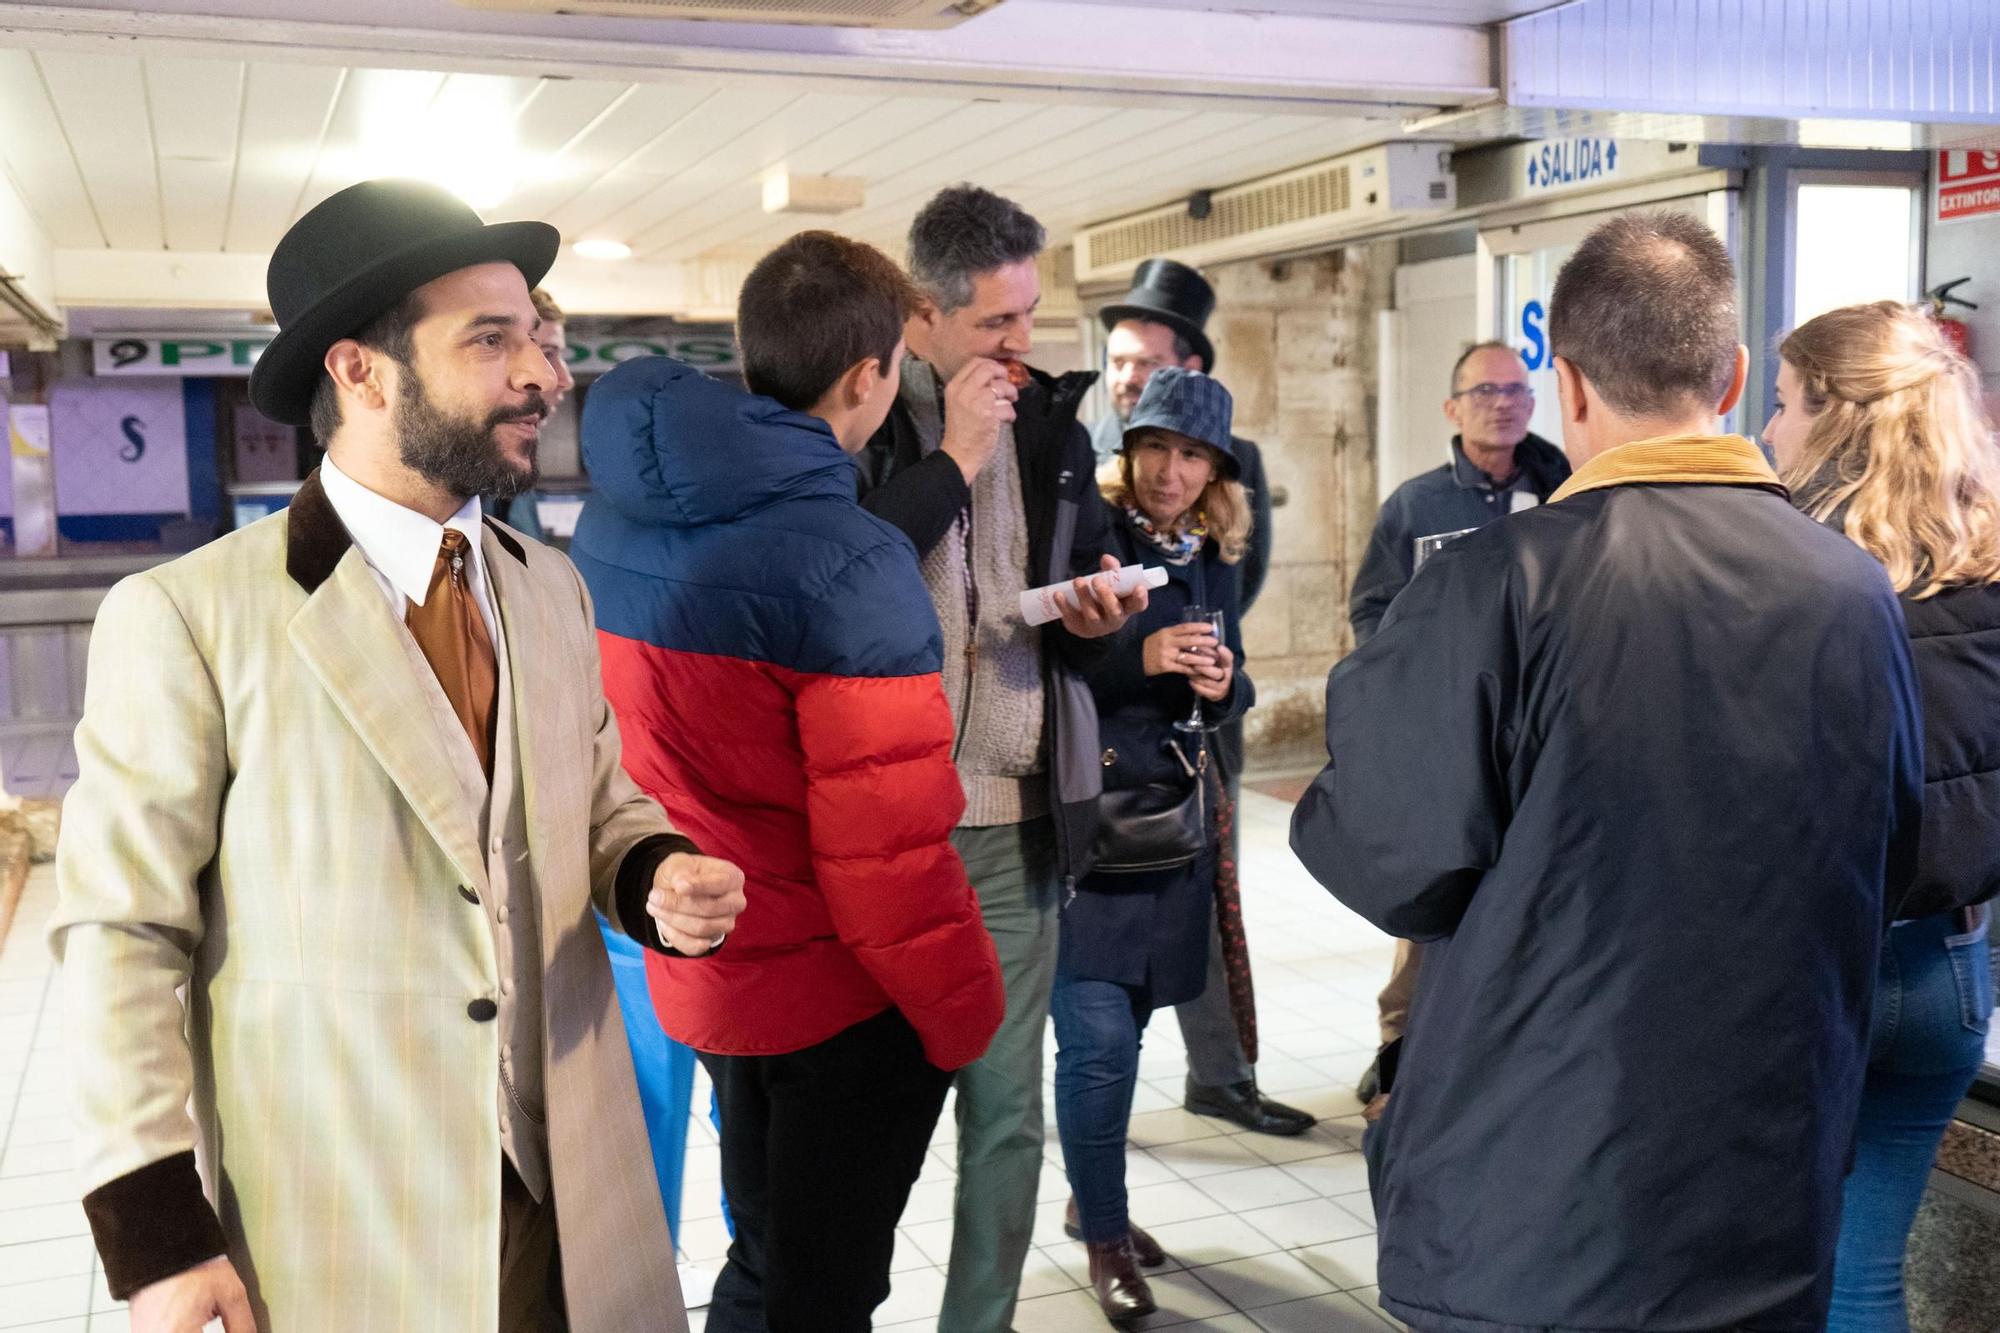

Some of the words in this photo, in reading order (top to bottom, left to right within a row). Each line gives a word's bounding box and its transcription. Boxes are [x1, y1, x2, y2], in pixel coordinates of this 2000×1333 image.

[1541, 138, 1602, 186] SALIDA
[1940, 186, 2000, 211] EXTINTOR
[1519, 299, 1554, 371] S
